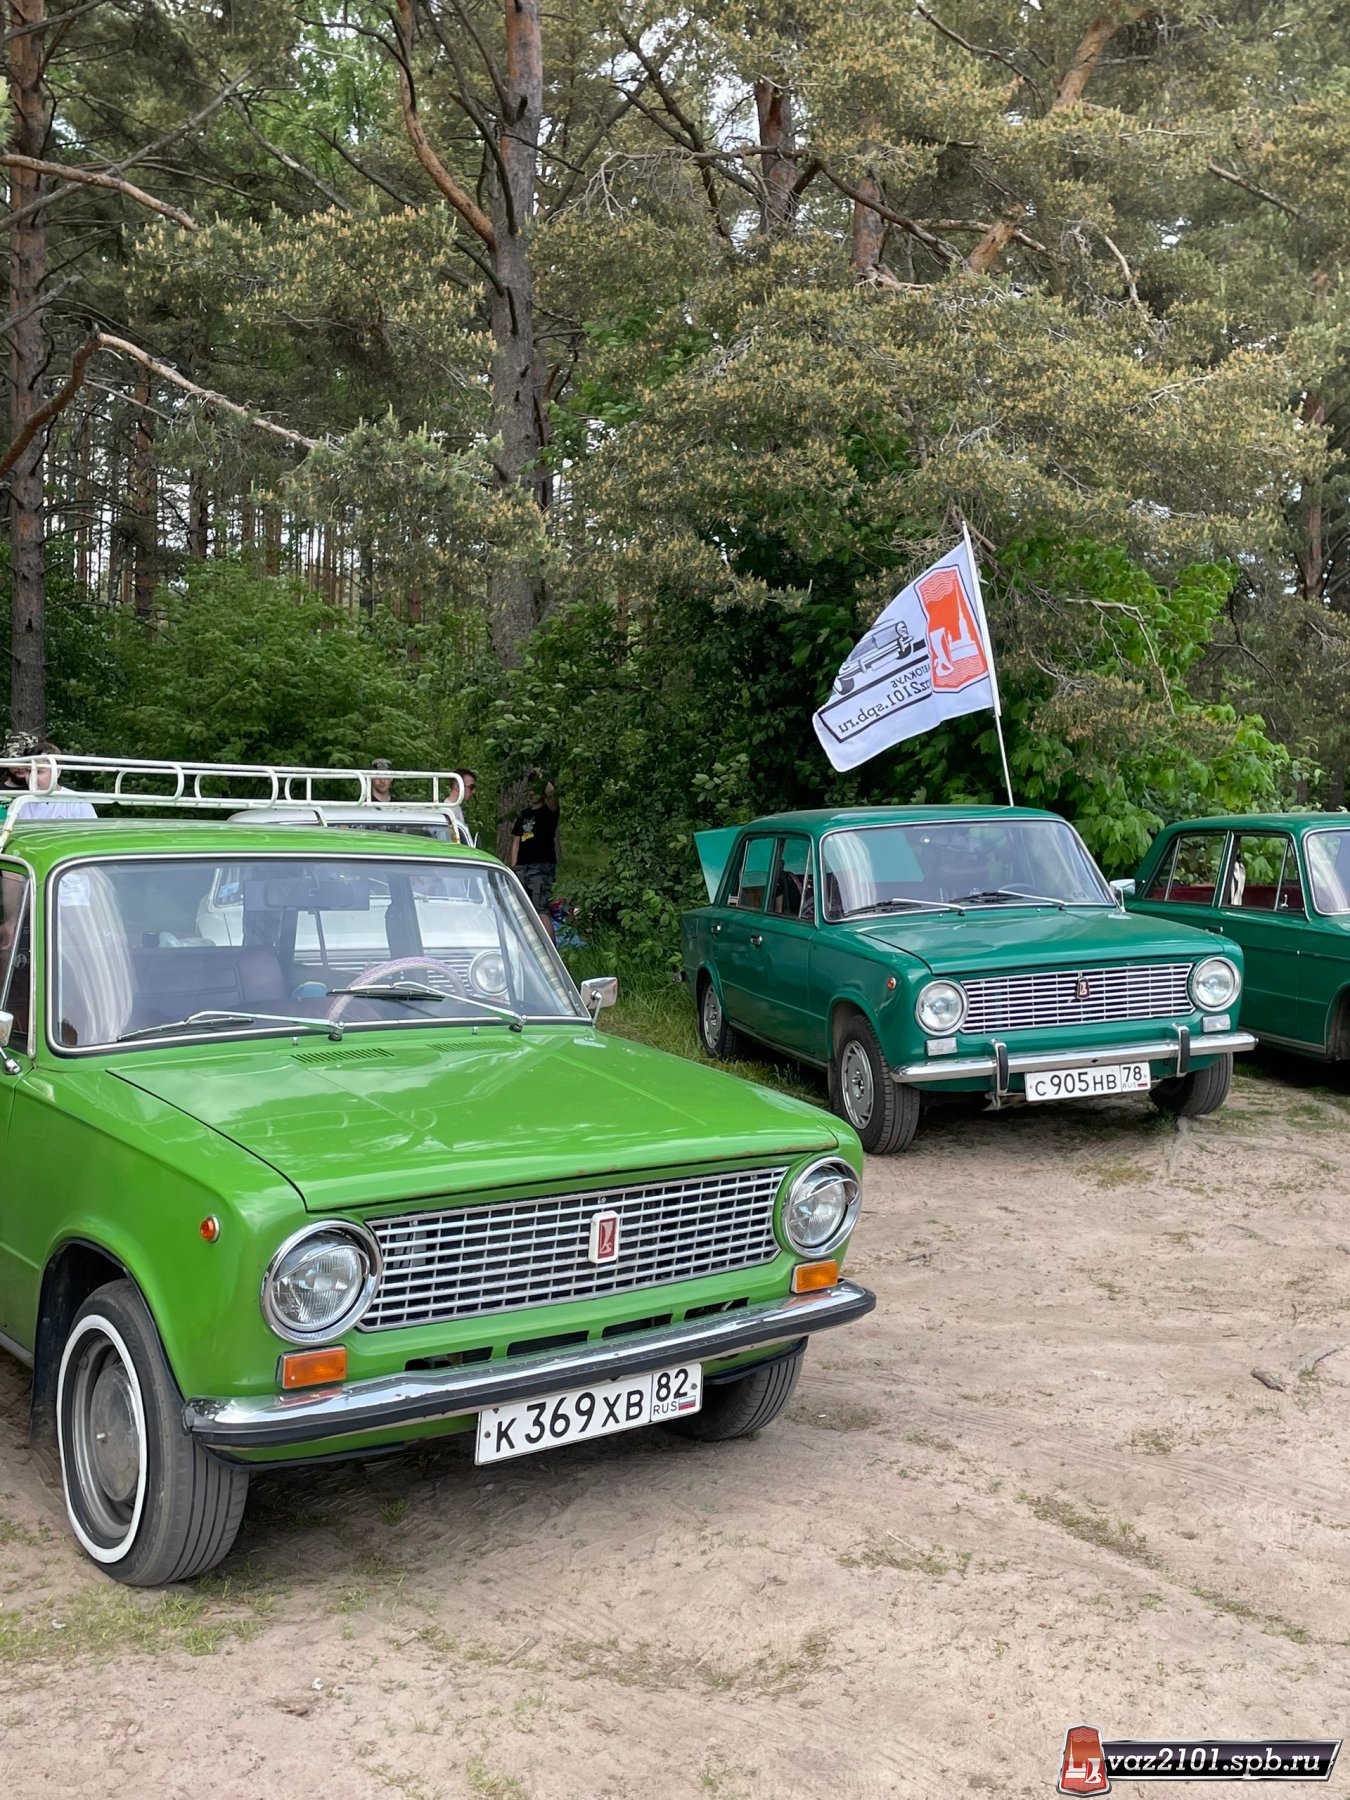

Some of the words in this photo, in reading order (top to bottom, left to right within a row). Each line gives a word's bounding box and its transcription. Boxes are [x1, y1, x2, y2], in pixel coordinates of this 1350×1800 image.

[1035, 1072, 1117, 1096] С905НВ
[1122, 1065, 1142, 1083] 78
[496, 1389, 645, 1453] К369ХВ
[656, 1368, 689, 1402] 82
[653, 1400, 677, 1415] RUS
